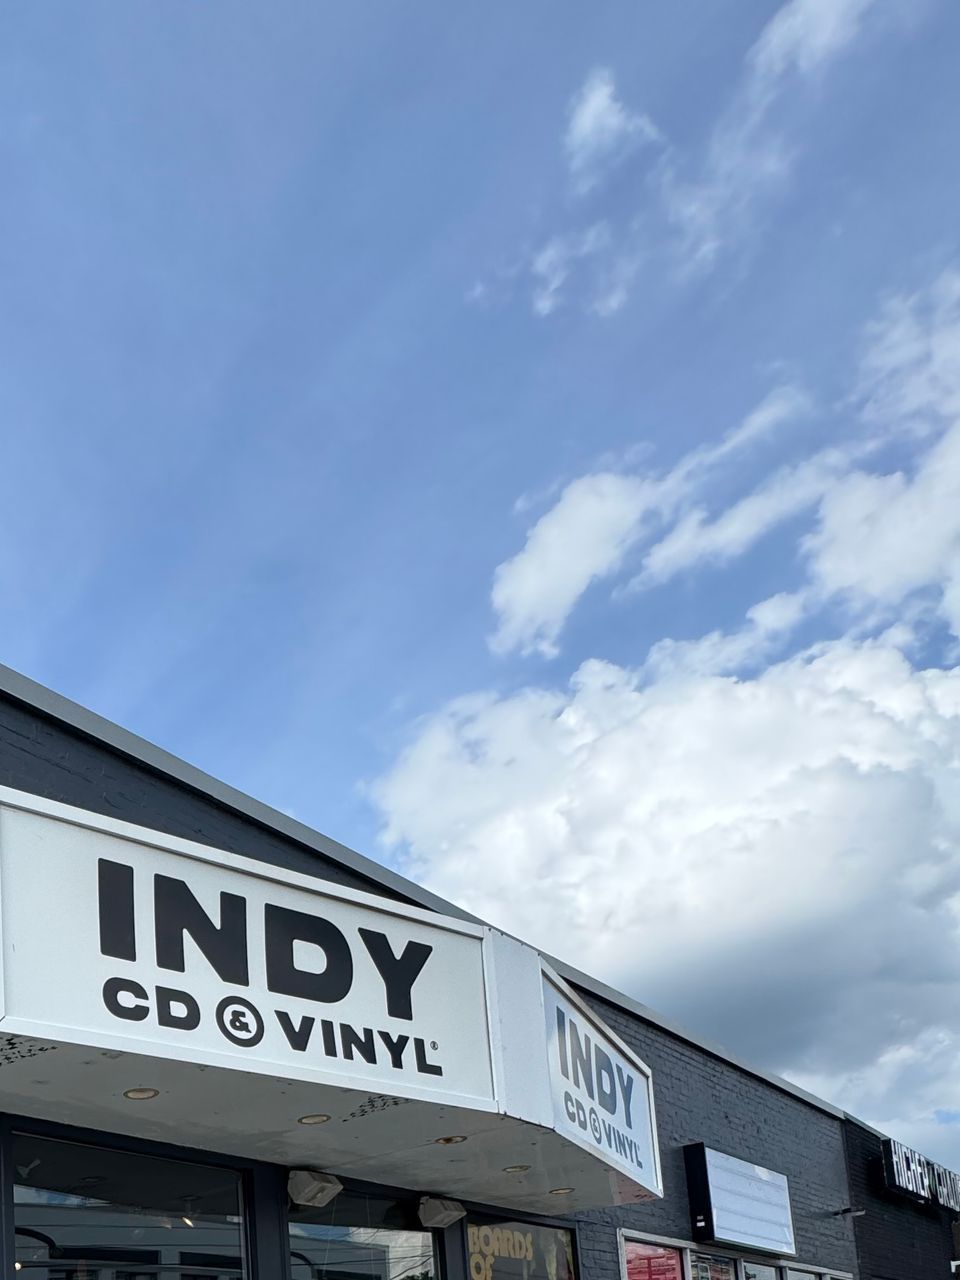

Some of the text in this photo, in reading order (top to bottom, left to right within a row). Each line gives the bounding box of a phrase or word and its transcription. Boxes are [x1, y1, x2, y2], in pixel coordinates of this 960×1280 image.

[97, 857, 434, 1021] INDY
[102, 976, 201, 1031] CD
[556, 1005, 634, 1130] INDY
[563, 1090, 643, 1170] CD VINYL
[468, 1225, 535, 1261] BOARDS
